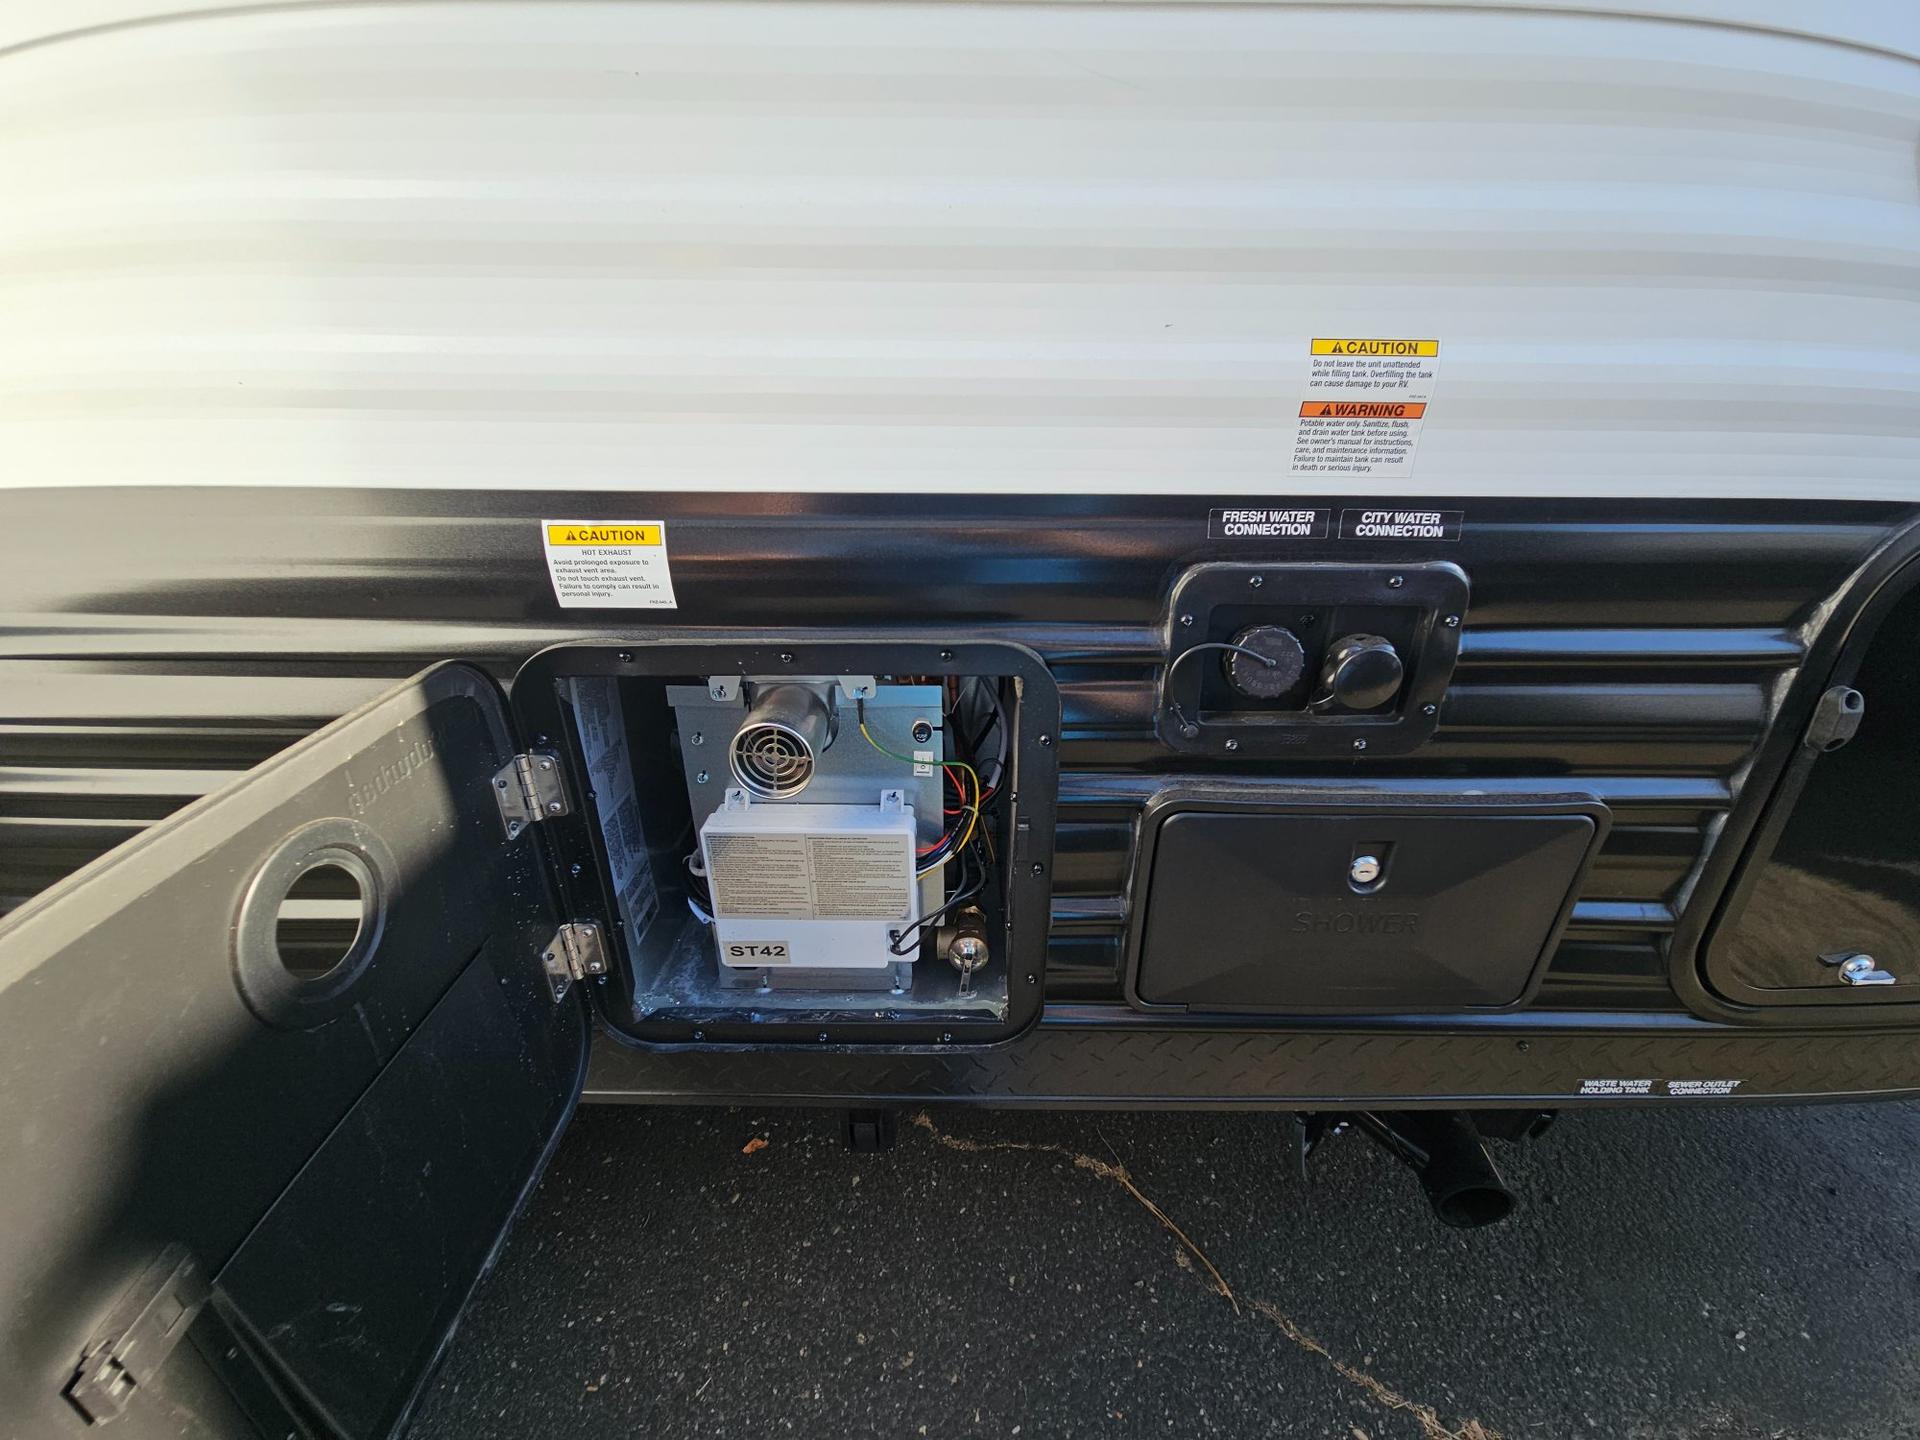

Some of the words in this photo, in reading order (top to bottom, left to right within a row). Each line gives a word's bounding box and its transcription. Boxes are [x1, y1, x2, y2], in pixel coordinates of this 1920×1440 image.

[1346, 342, 1418, 354] CAUTION
[1313, 360, 1322, 368] Do
[1323, 360, 1335, 368] not
[1336, 360, 1354, 368] leave
[1312, 370, 1330, 378] while
[1332, 370, 1350, 378] filling
[1371, 371, 1404, 379] Overfilling
[1345, 380, 1372, 389] damage
[1382, 381, 1396, 389] your
[1335, 405, 1405, 416] WARNING
[1346, 420, 1360, 429] only.
[1363, 421, 1390, 429] Sanitize,
[1389, 430, 1408, 438] using.
[1374, 438, 1413, 446] instructions,
[1352, 465, 1372, 473] injury.
[1222, 512, 1266, 522] FRESH
[1269, 512, 1315, 522] WATER
[1362, 512, 1392, 523] CITY
[1395, 513, 1441, 524] WATER
[1224, 524, 1311, 535] CONNECTION
[1356, 524, 1443, 537] CONNECTION
[579, 530, 645, 541] CAUTION
[1292, 911, 1419, 933] SHOWER
[730, 946, 786, 956] ST42
